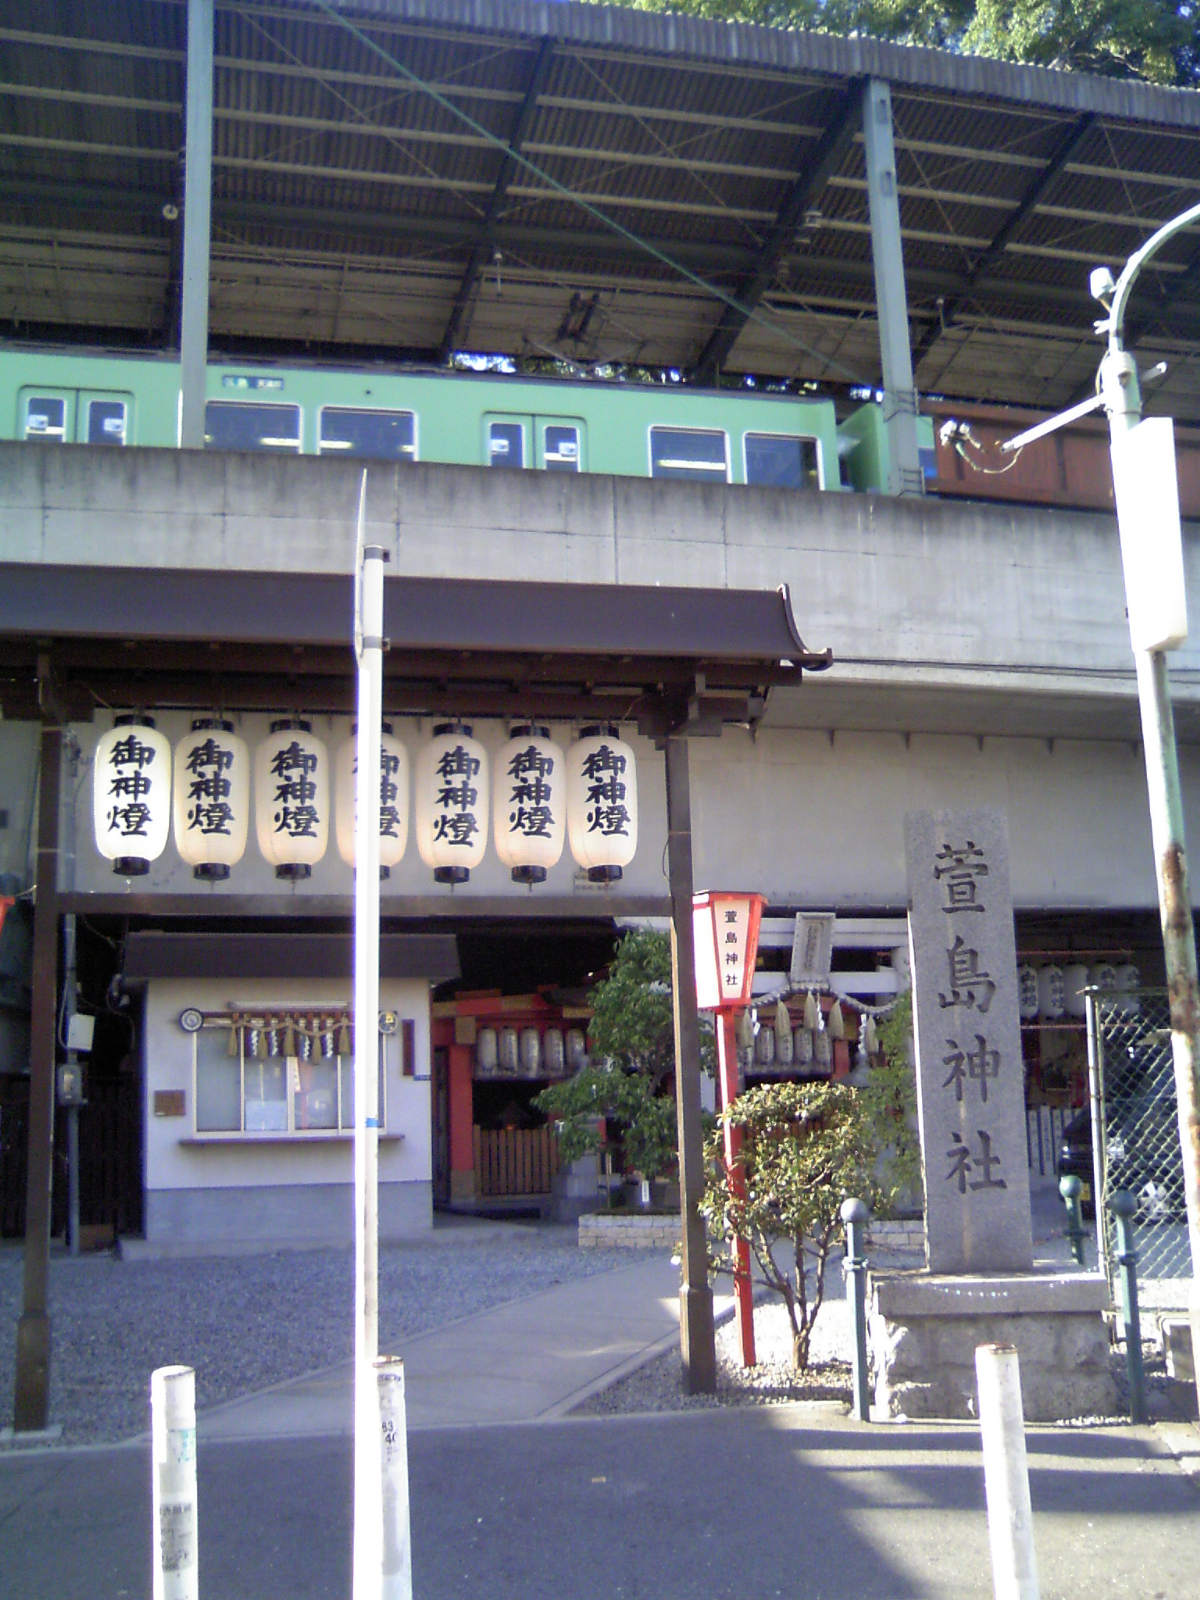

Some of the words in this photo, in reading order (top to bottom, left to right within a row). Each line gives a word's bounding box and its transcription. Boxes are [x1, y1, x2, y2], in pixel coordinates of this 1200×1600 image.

[107, 734, 157, 837] 御神燈
[186, 737, 236, 836] 御神燈
[270, 740, 319, 839] 御神燈
[433, 745, 481, 848] 御神燈
[507, 744, 555, 838] 御神燈
[581, 744, 631, 838] 御神燈
[724, 910, 739, 986] 萱島神社
[933, 840, 1007, 1195] 萱島神社
